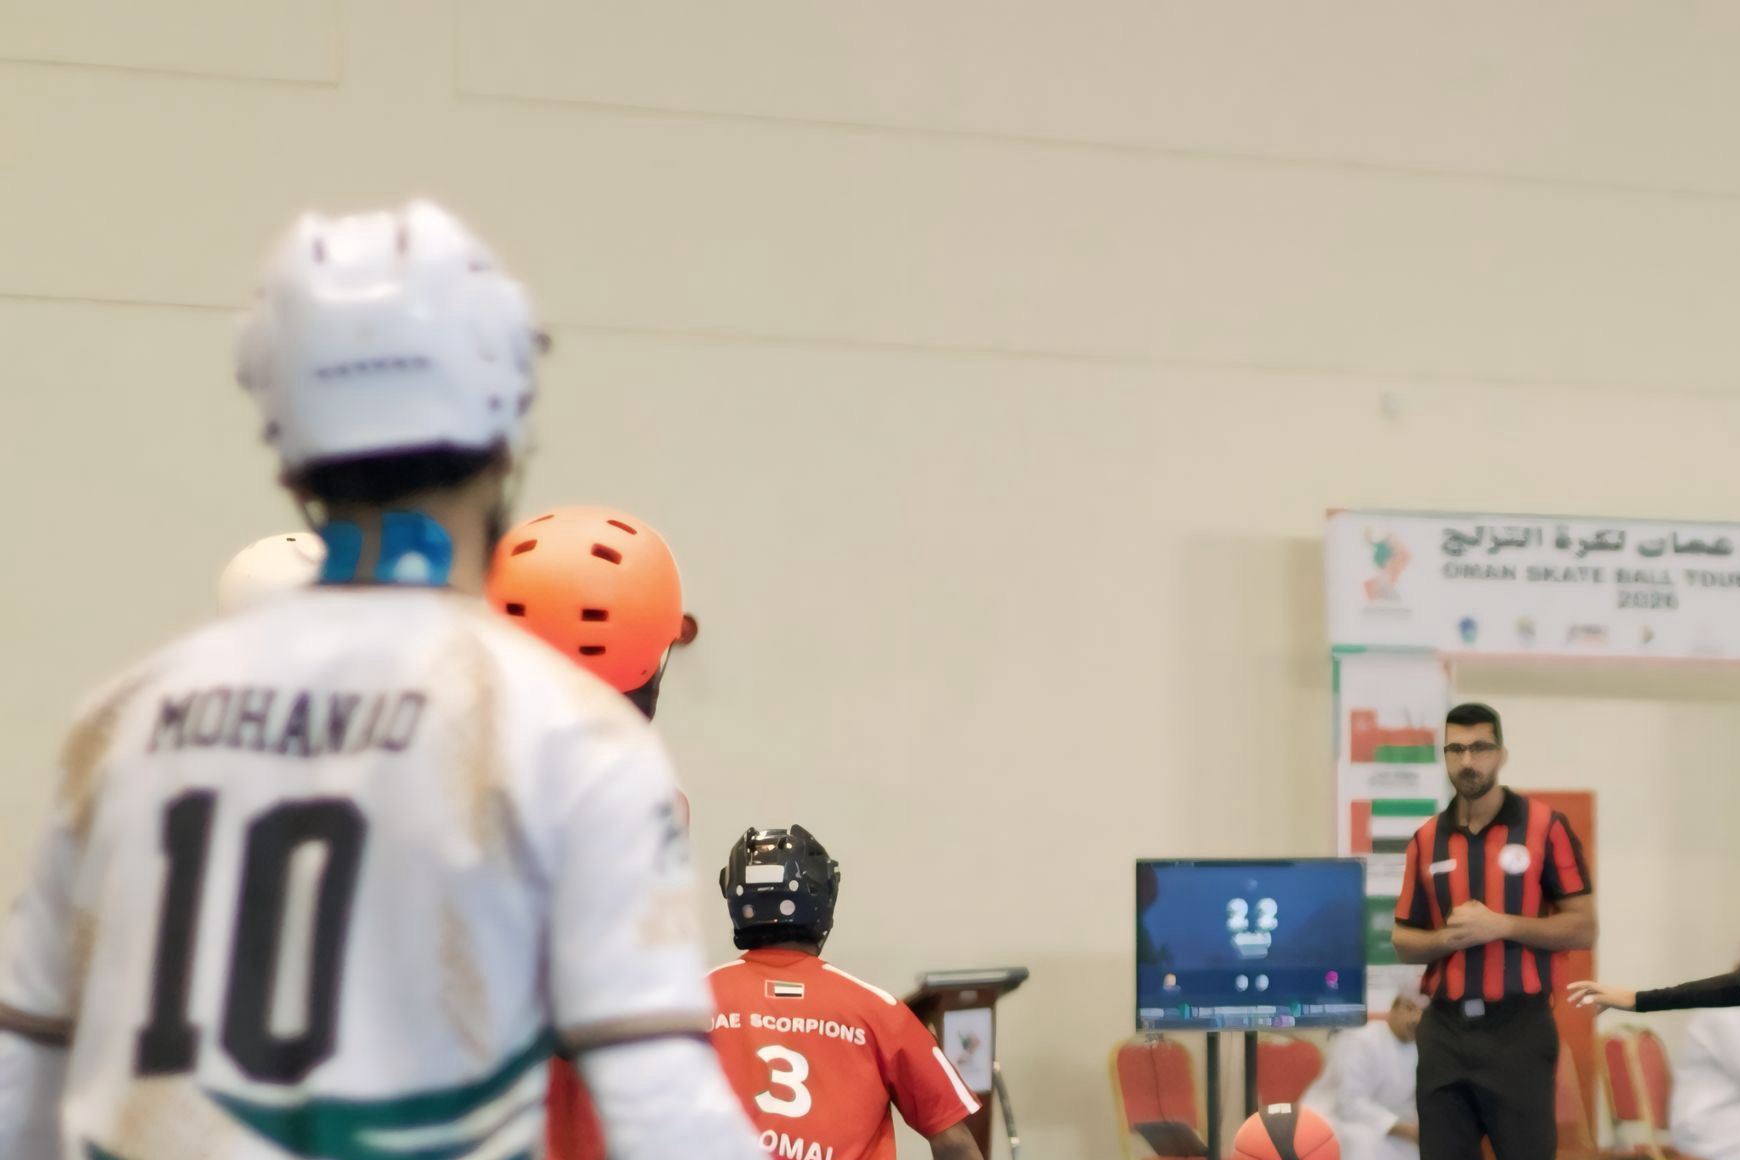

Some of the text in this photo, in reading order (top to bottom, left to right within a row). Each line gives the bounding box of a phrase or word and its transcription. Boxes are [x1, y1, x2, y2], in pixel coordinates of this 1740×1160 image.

[1553, 524, 1627, 559] لكرة
[1636, 530, 1733, 559] عمان
[1442, 562, 1517, 581] OMAN
[1526, 566, 1605, 583] SKATE
[1615, 568, 1673, 586] BALL
[133, 786, 369, 1087] 10
[750, 1013, 867, 1046] SCORPIONS
[754, 1044, 812, 1118] 3
